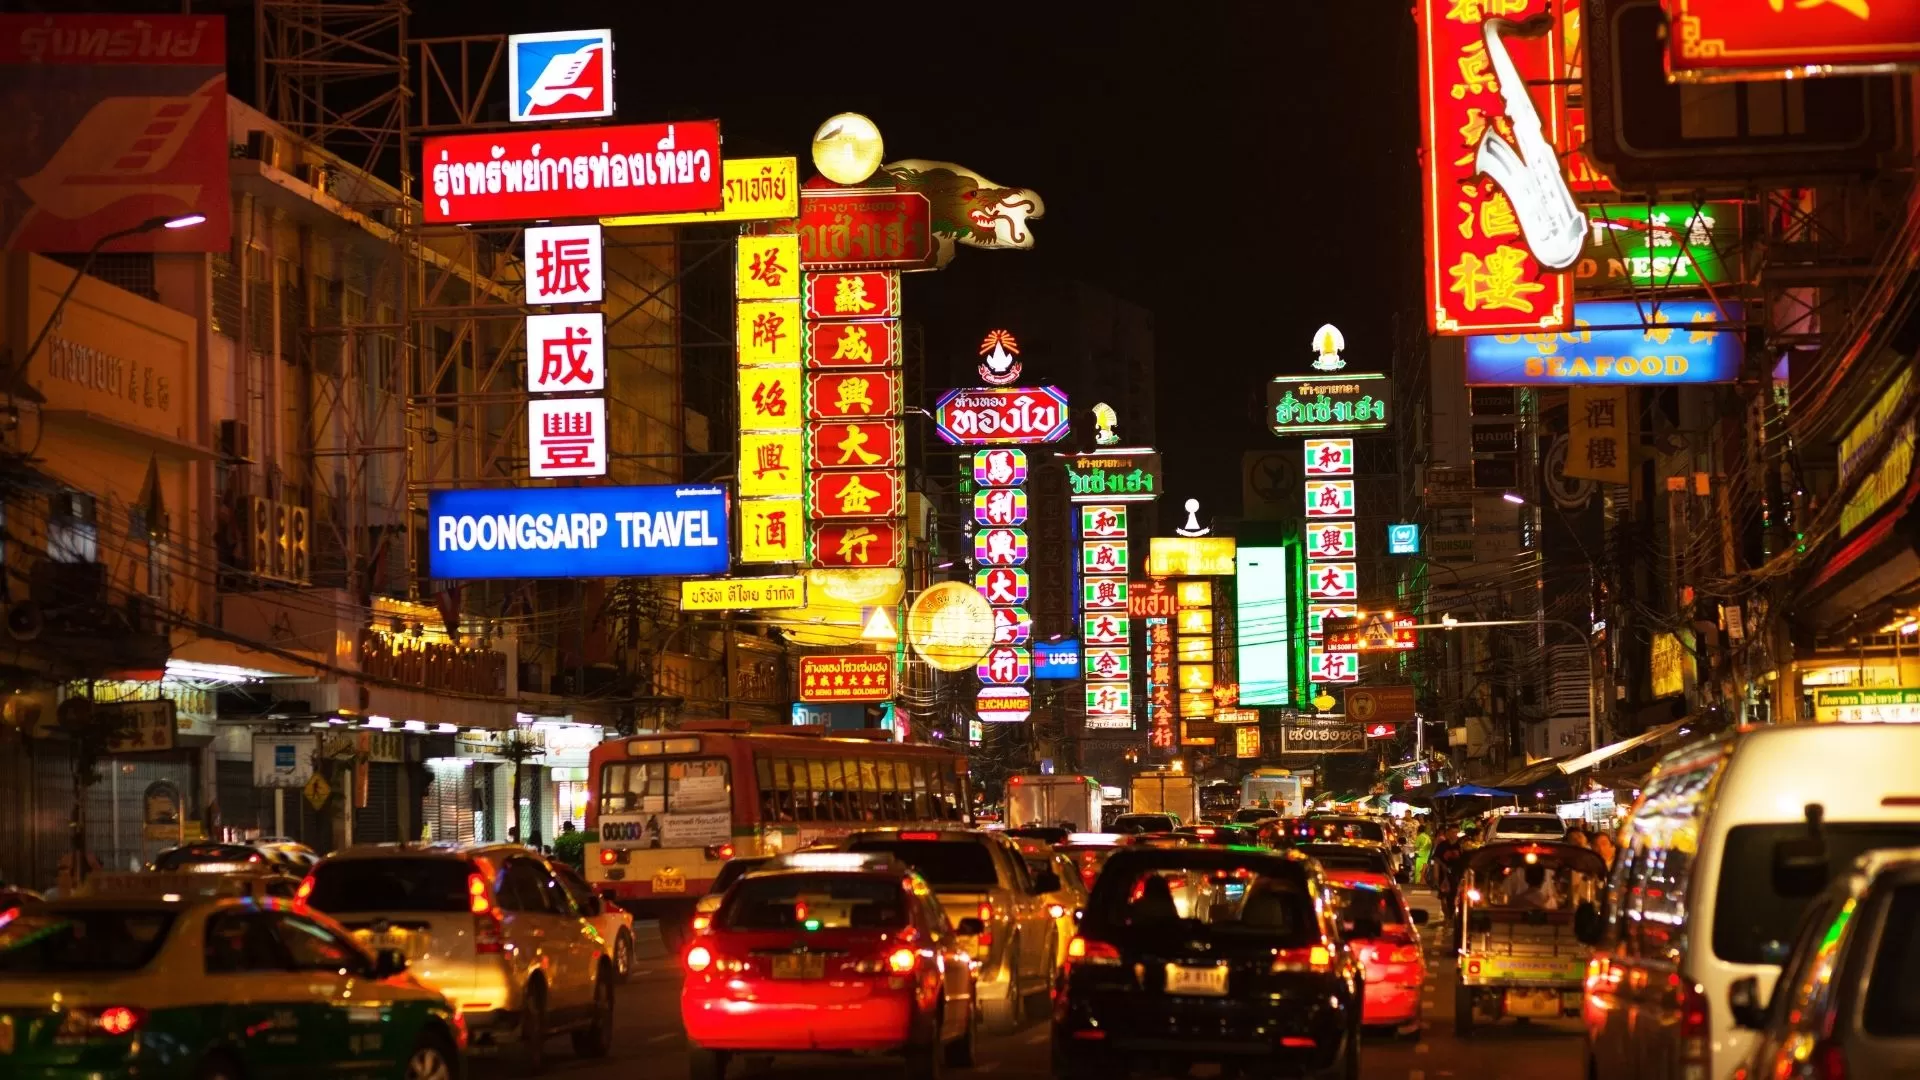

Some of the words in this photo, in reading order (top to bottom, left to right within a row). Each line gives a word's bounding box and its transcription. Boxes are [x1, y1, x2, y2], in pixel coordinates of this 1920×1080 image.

[433, 125, 711, 215] รุ่งทรัพย์การท่องเที่ยว
[1608, 257, 1690, 278] NEST
[535, 238, 595, 469] 振成豐
[1524, 356, 1689, 378] SEAFOOD
[749, 252, 789, 548] 塔牌紹興酒
[951, 396, 1056, 433] ทองใบ
[954, 393, 1008, 409] ห้างทอง
[831, 277, 882, 563] 蘇成興大金行
[1587, 398, 1617, 470] 酒樓
[438, 513, 608, 552] ROONGSARP
[615, 509, 718, 549] TRAVEL
[692, 586, 723, 604] บริษัท
[728, 585, 760, 602] ดีไทย
[765, 584, 795, 601] จำกัด
[1095, 512, 1119, 710] 和成興大金行
[1049, 652, 1078, 665] UOB
[805, 688, 814, 696] SO
[852, 687, 888, 695] GOLDSMITH
[978, 699, 1028, 709] EXCHANGE
